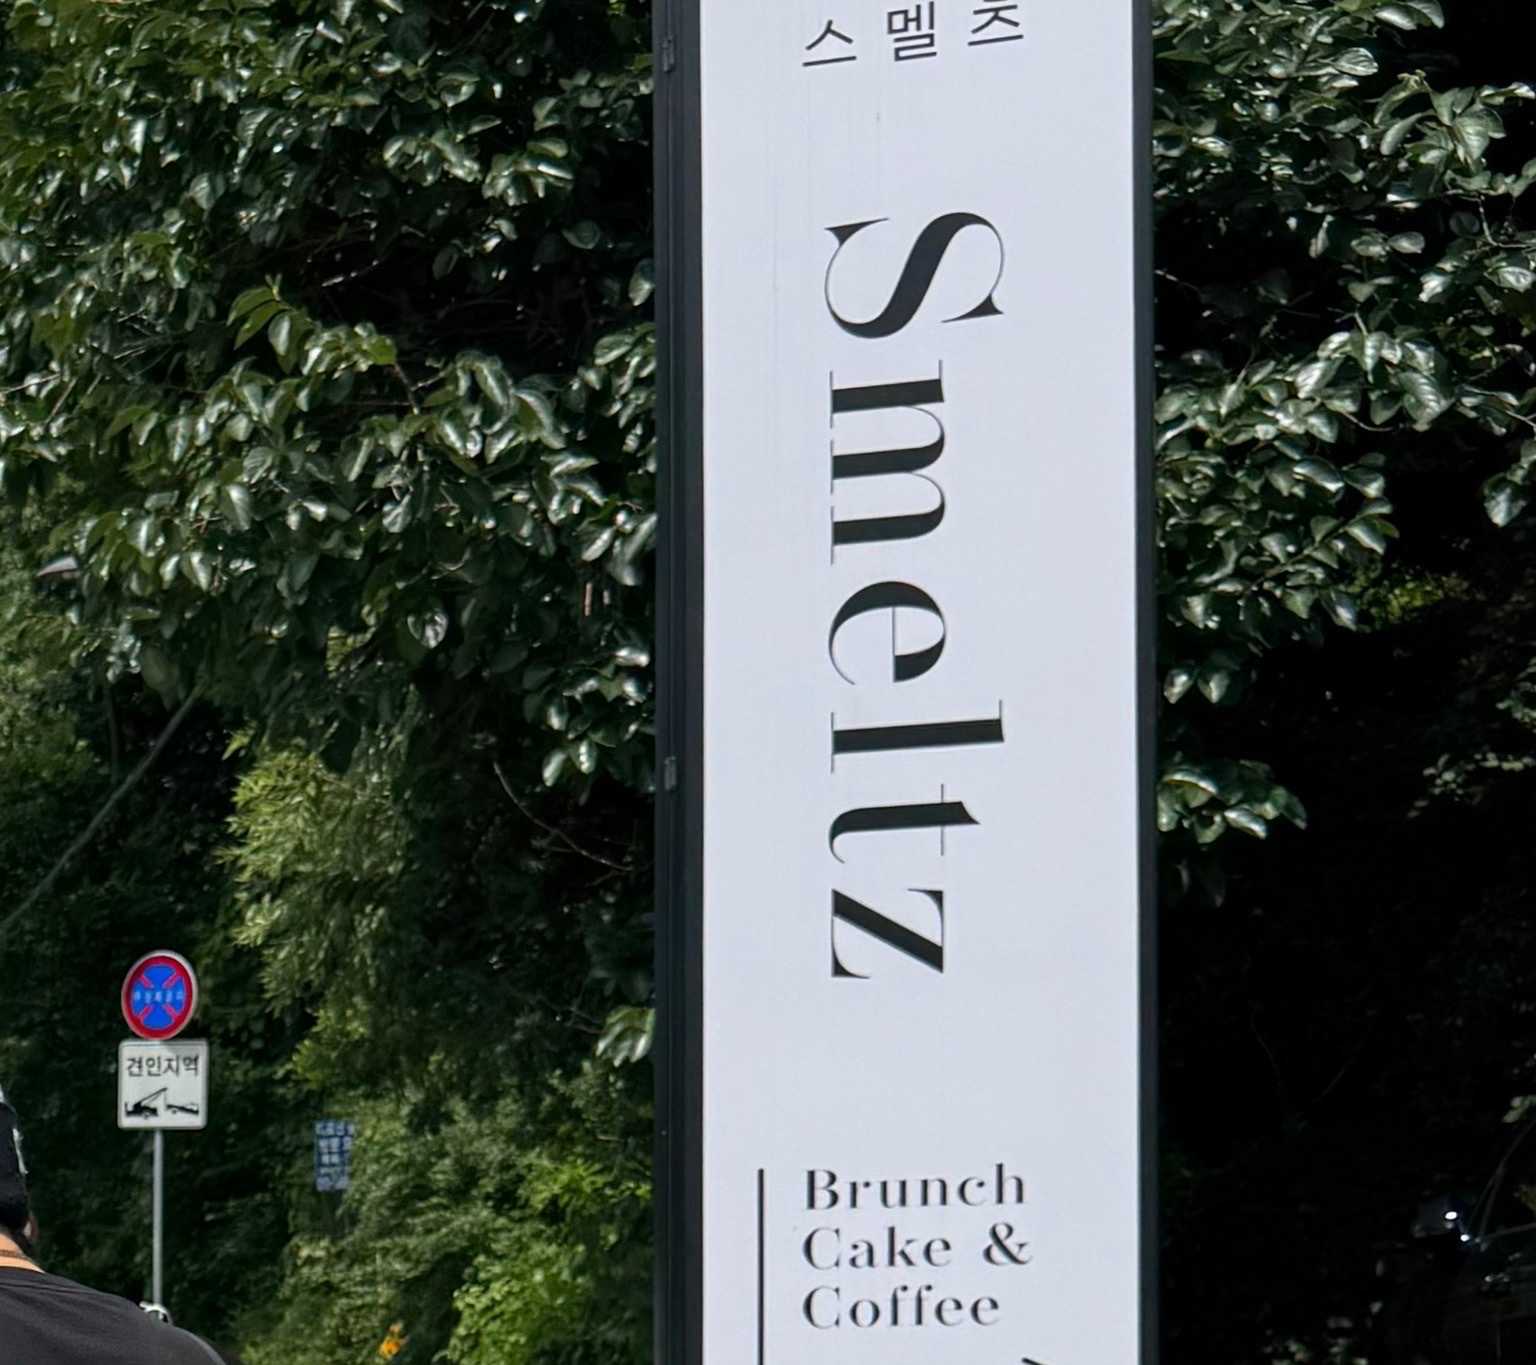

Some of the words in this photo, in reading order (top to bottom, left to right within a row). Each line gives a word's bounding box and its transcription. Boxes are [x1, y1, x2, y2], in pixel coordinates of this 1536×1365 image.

[802, 0, 1024, 67] 스멜츠
[824, 212, 1005, 978] Smeltz
[126, 1054, 200, 1077] 견인지역
[804, 1162, 1026, 1211] Brunch
[802, 1226, 952, 1270] Cake
[982, 1222, 1033, 1266] &
[802, 1284, 1001, 1329] Coffee
